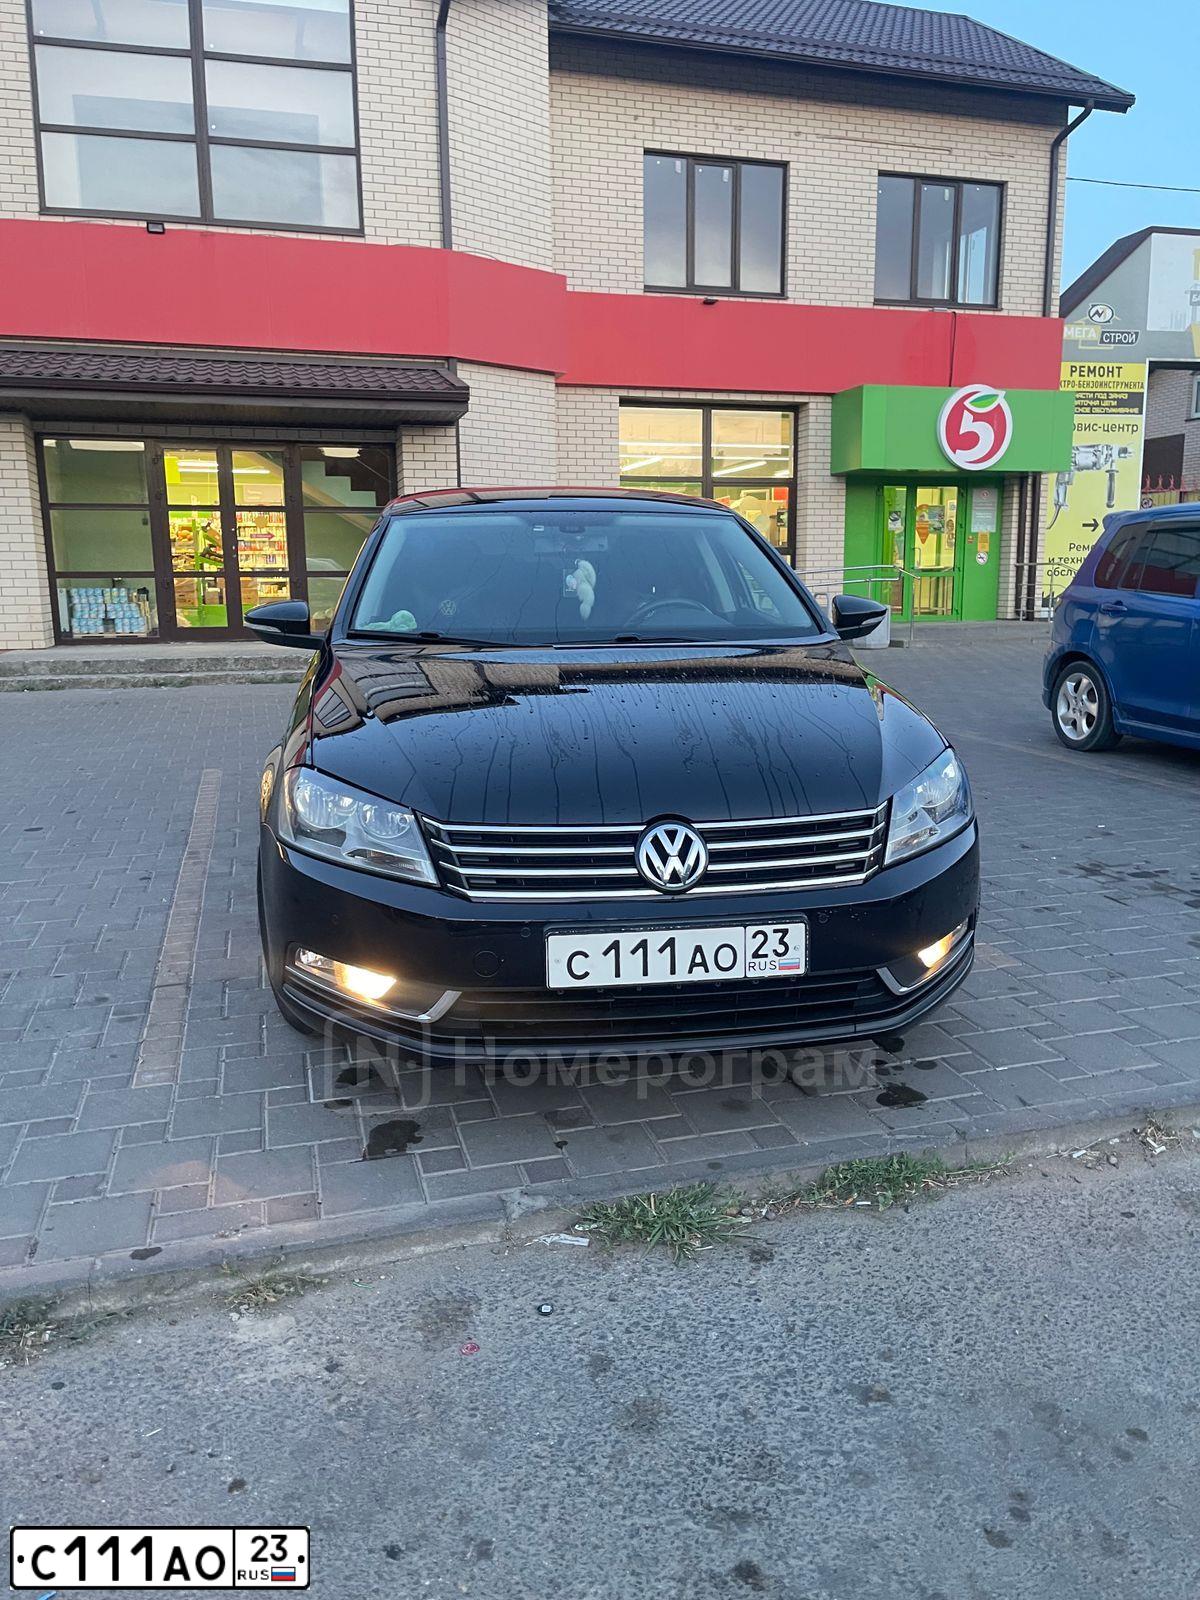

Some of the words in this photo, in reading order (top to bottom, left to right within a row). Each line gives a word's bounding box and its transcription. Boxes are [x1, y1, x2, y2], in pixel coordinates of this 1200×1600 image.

[1064, 327, 1097, 339] МЕГА
[1102, 331, 1136, 343] СТРОЙ
[1070, 365, 1123, 378] РЕМОНТ
[954, 409, 995, 464] 5
[1058, 556, 1086, 564] техн
[751, 927, 790, 959] 23
[748, 960, 777, 972] RUS
